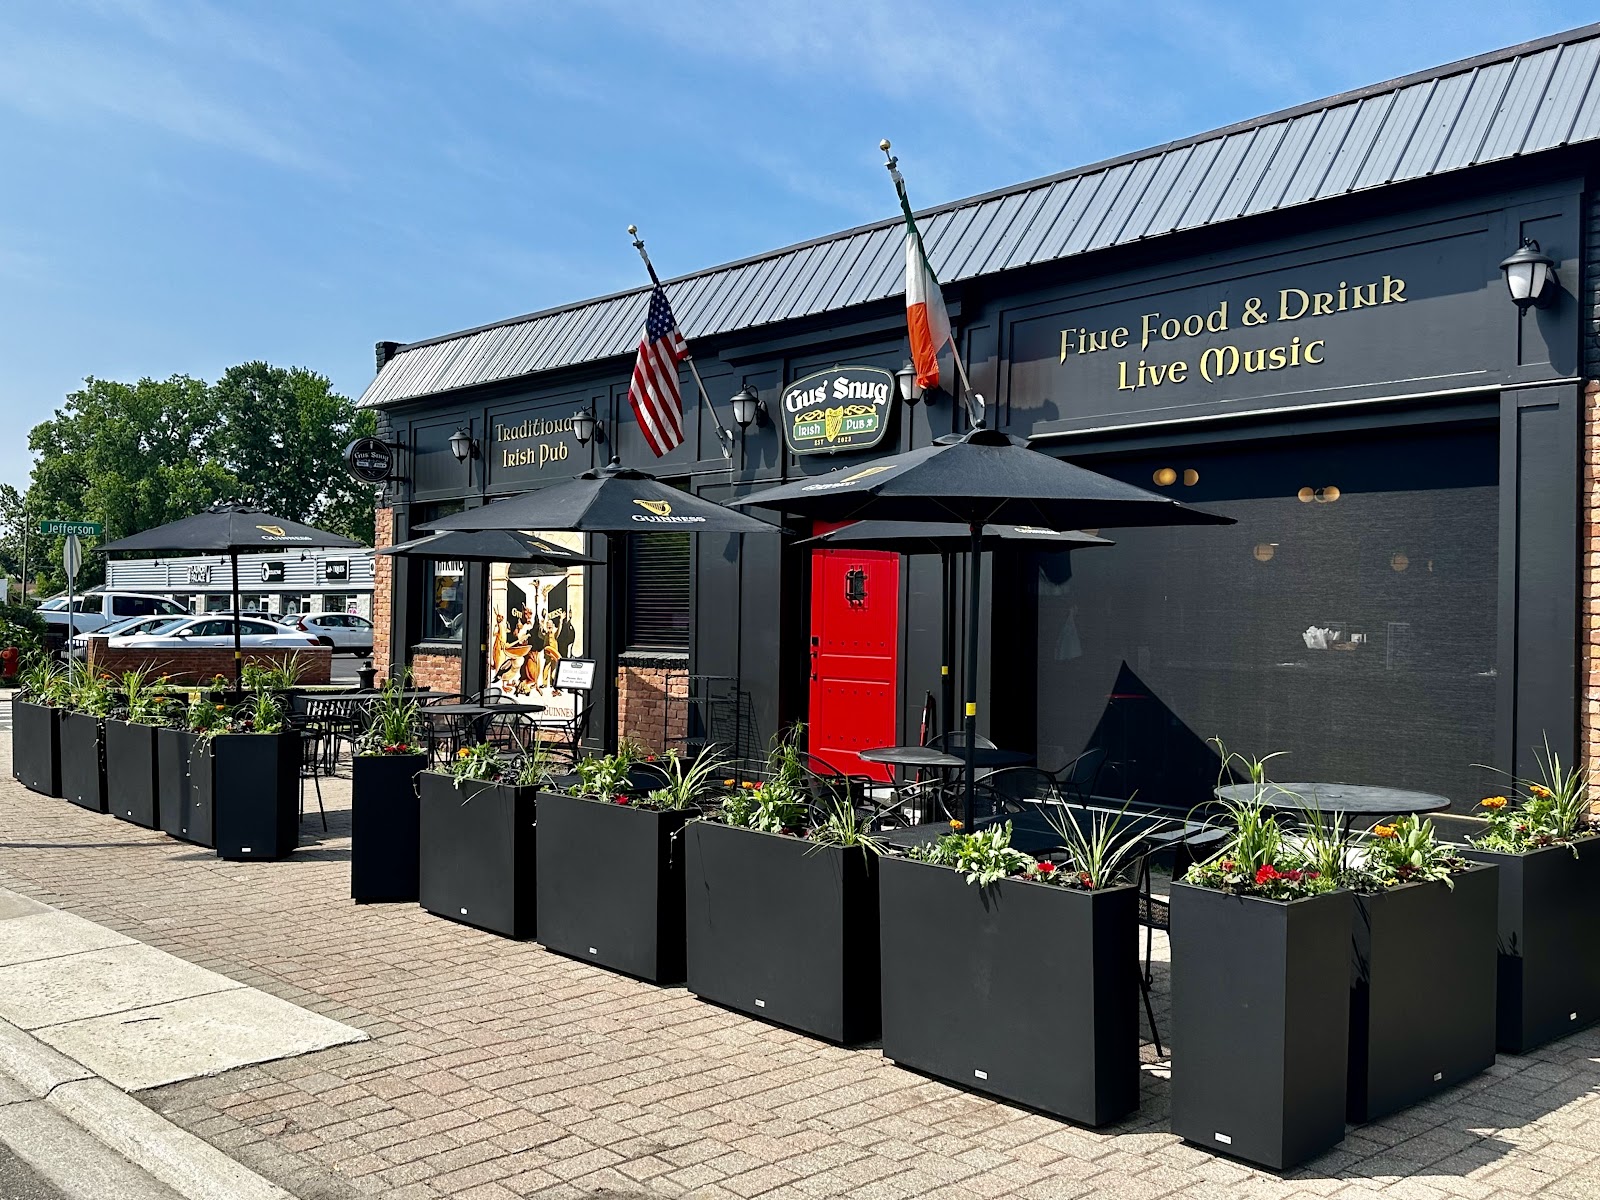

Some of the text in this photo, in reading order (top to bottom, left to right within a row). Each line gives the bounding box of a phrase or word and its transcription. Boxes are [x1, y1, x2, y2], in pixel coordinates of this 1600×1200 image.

[1060, 275, 1407, 365] Fine Food & Drink
[1118, 336, 1325, 391] Live Music
[833, 377, 888, 406] Snug
[495, 412, 576, 441] Traditiona
[503, 442, 568, 469] Irish Pub
[48, 523, 94, 535] Jefferson
[632, 514, 706, 523] GUINNESS
[544, 704, 574, 718] GUINNES
